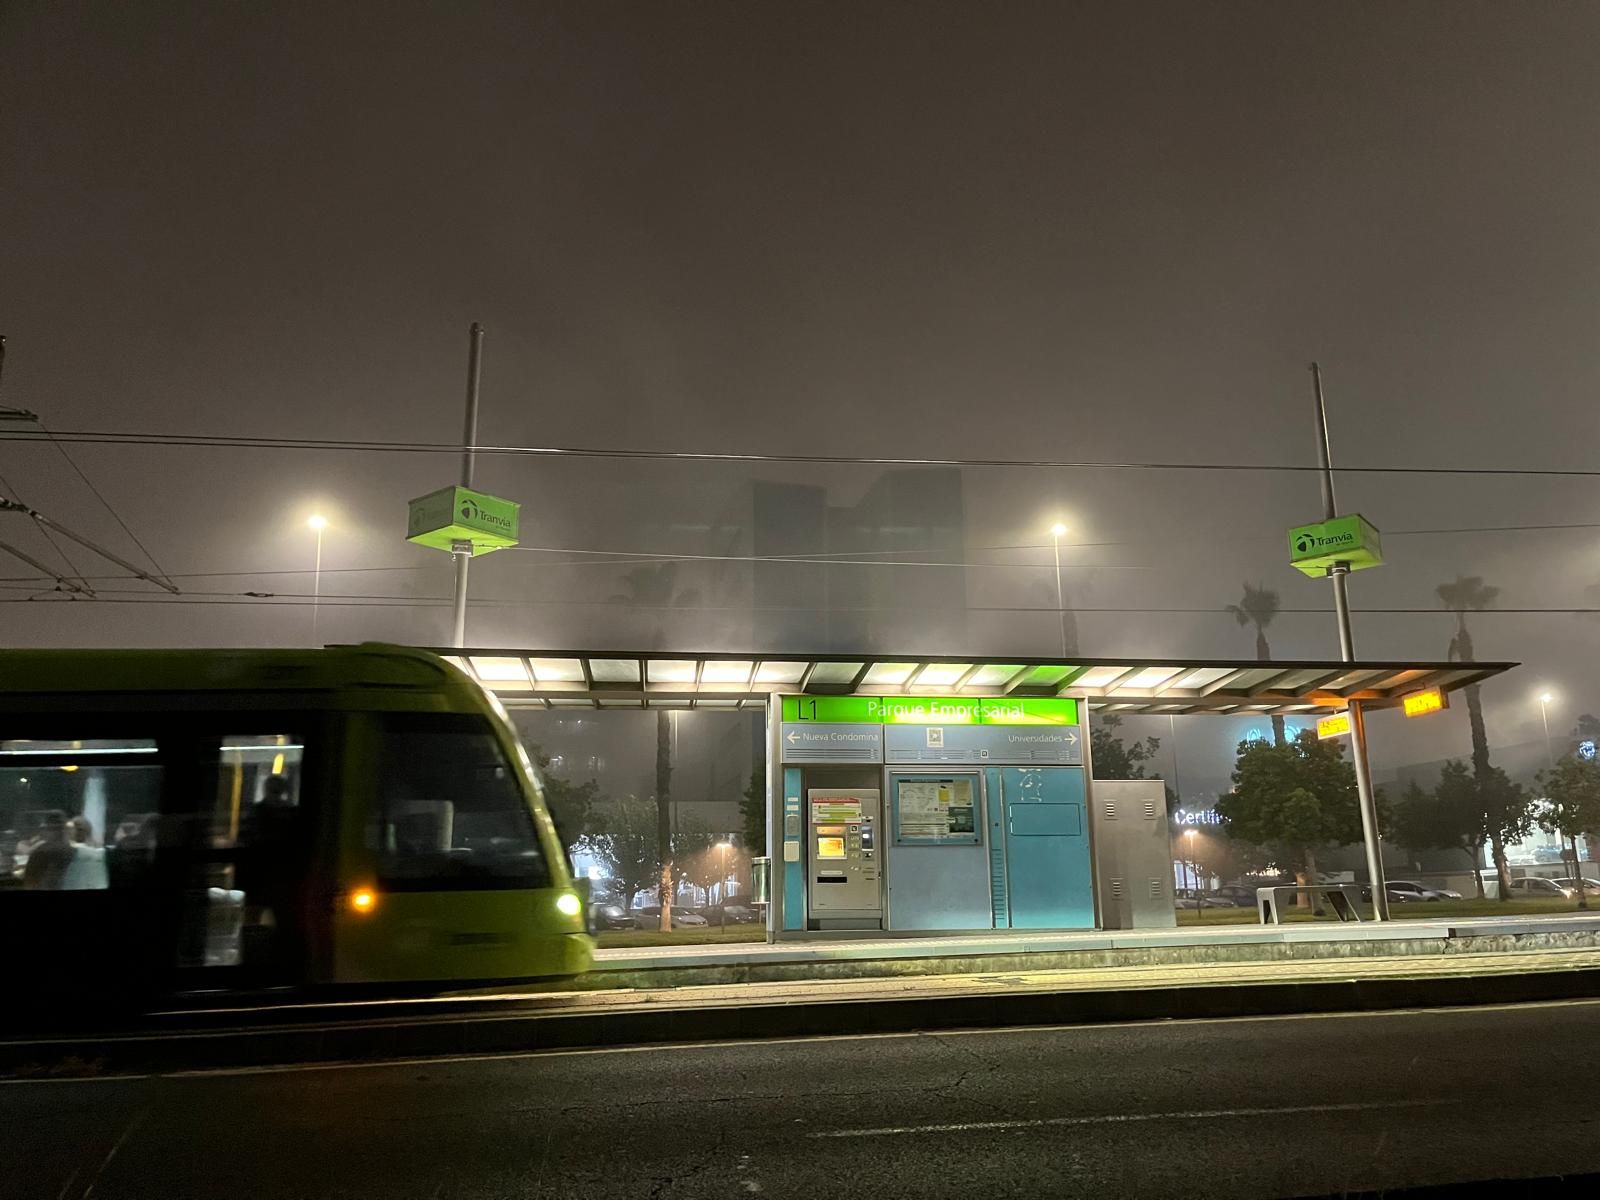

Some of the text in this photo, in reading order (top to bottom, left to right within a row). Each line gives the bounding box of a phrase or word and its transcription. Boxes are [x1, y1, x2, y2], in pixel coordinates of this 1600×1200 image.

[798, 699, 817, 720] L1
[868, 701, 1025, 721] Parque Empresarial
[802, 732, 879, 742] Nueva Condomina
[1008, 734, 1063, 743] Universidades
